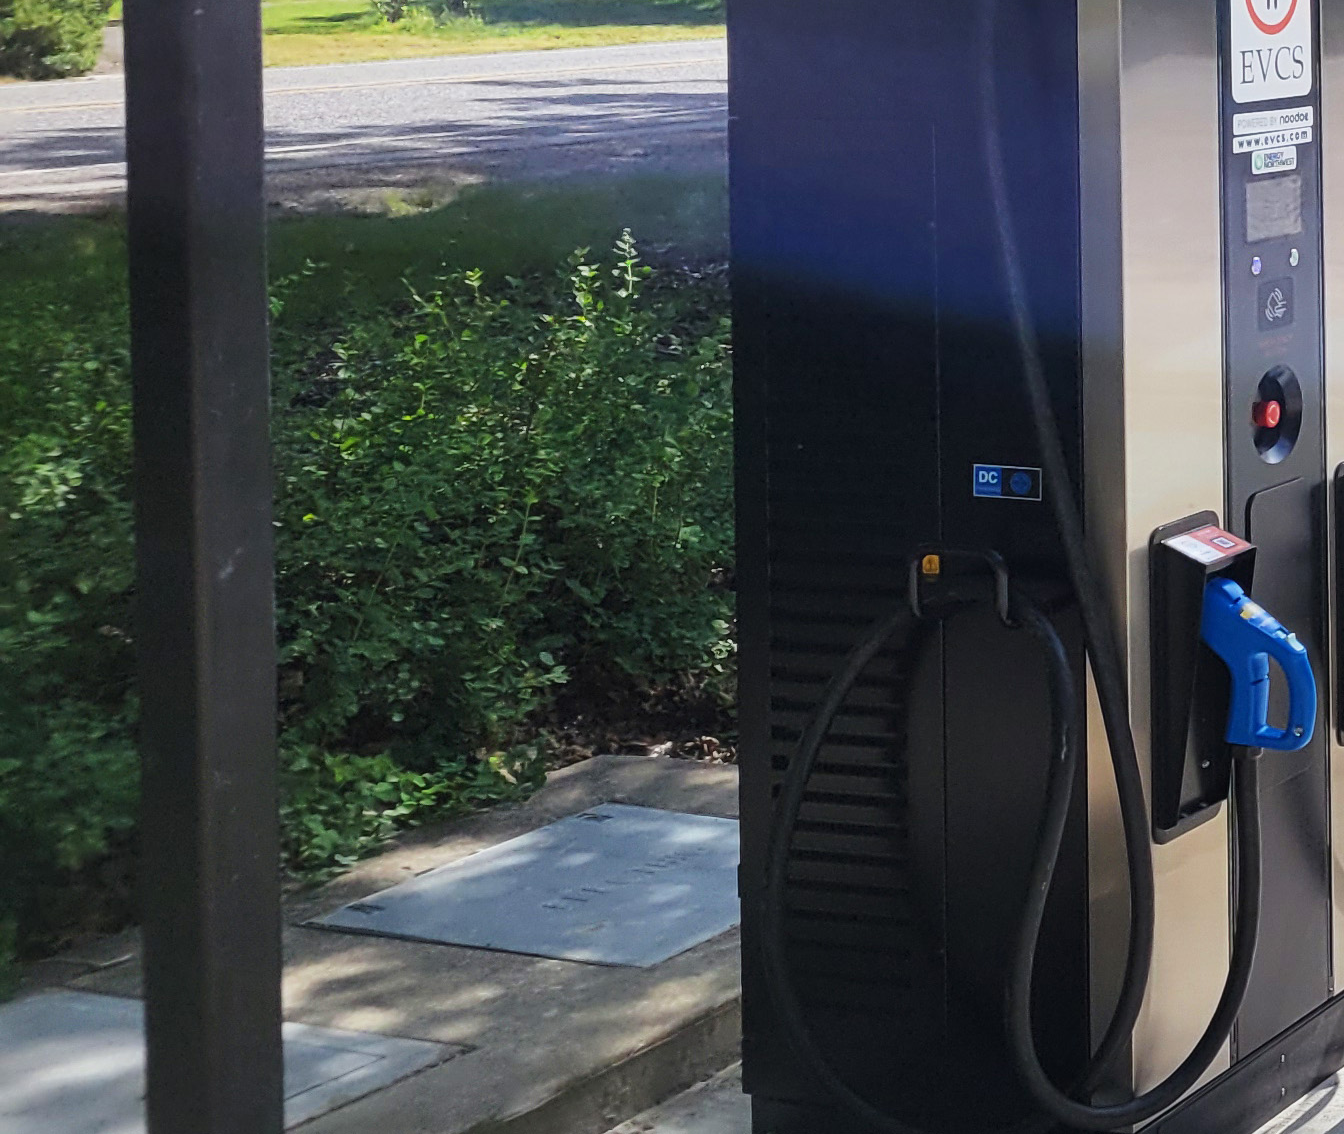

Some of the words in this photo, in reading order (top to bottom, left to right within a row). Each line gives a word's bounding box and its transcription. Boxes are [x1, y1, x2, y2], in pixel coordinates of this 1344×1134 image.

[1239, 45, 1304, 85] EVCS
[1279, 112, 1309, 126] noodoe
[1237, 131, 1308, 149] www.evcs.com
[978, 470, 998, 484] DC
